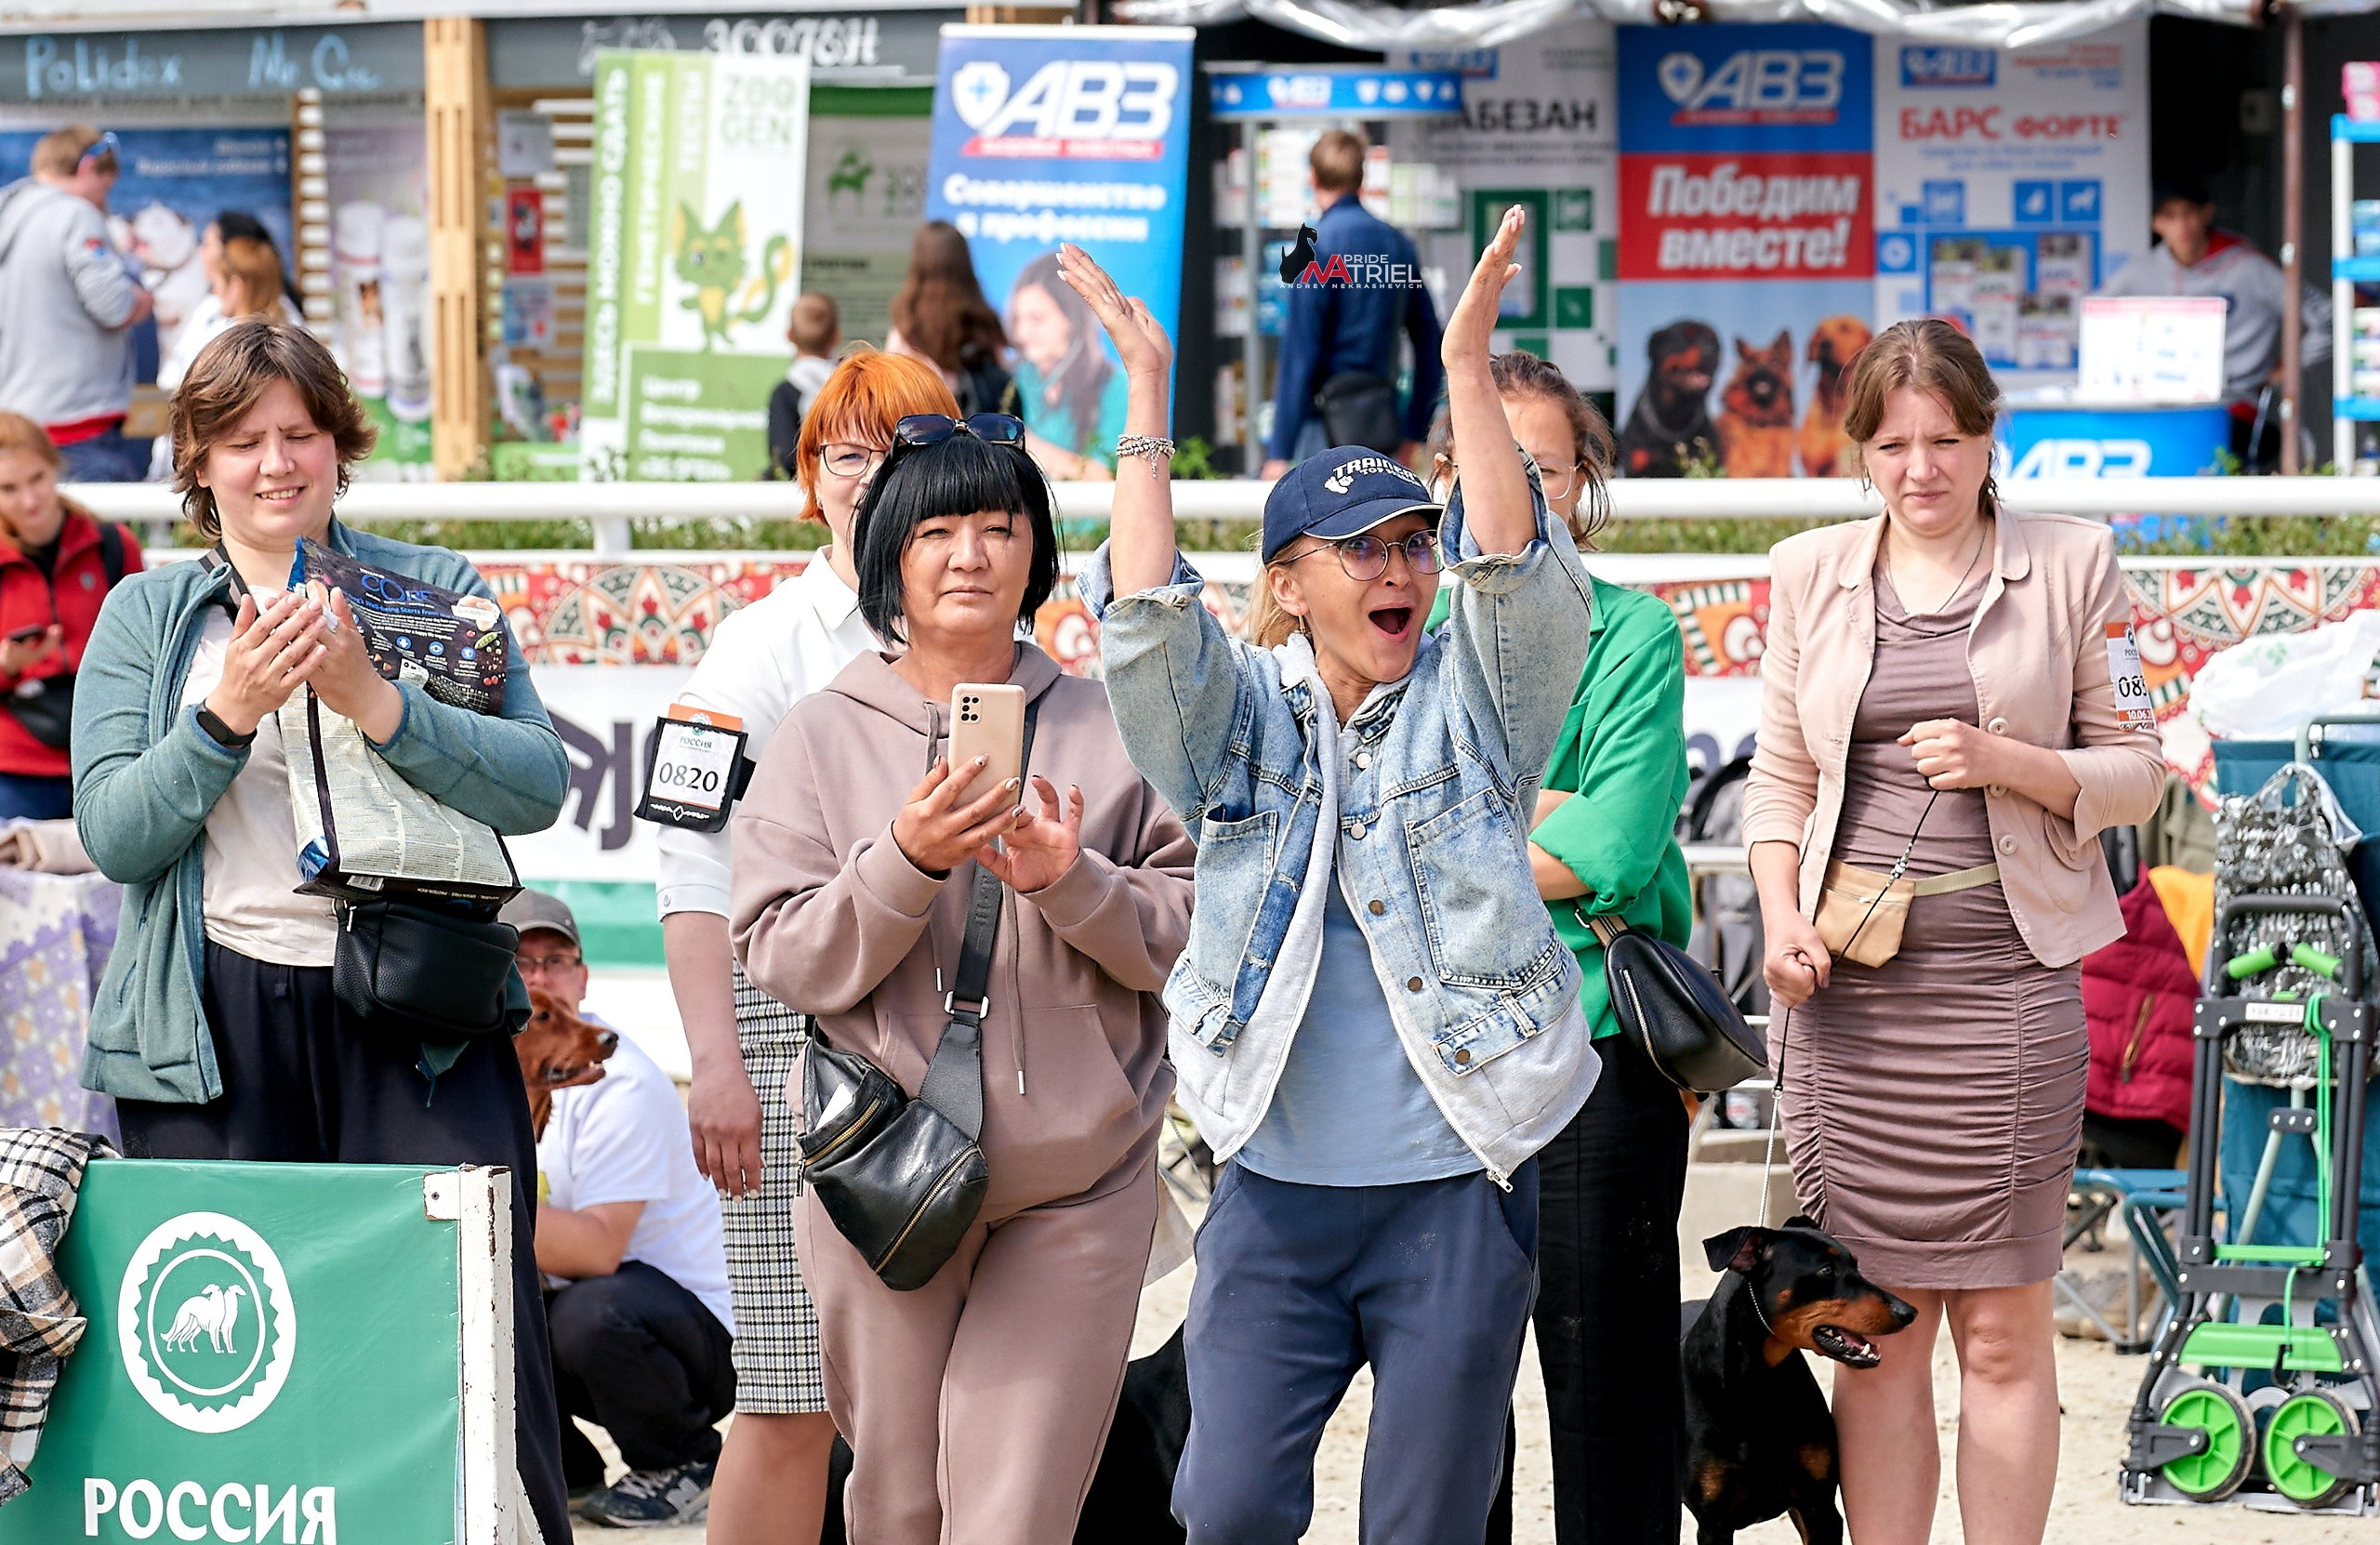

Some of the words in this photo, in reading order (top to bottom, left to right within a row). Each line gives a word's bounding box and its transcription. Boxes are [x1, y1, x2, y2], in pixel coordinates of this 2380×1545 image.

[982, 60, 1178, 139] АВЗ
[1689, 50, 1844, 110] АВЗ
[1899, 106, 2003, 140] БАРС
[1648, 163, 1859, 221] Победим
[1659, 217, 1852, 270] вместе!
[680, 736, 712, 748] РОССИЯ
[659, 762, 719, 792] 0820
[84, 1477, 337, 1545] РОССИЯ
